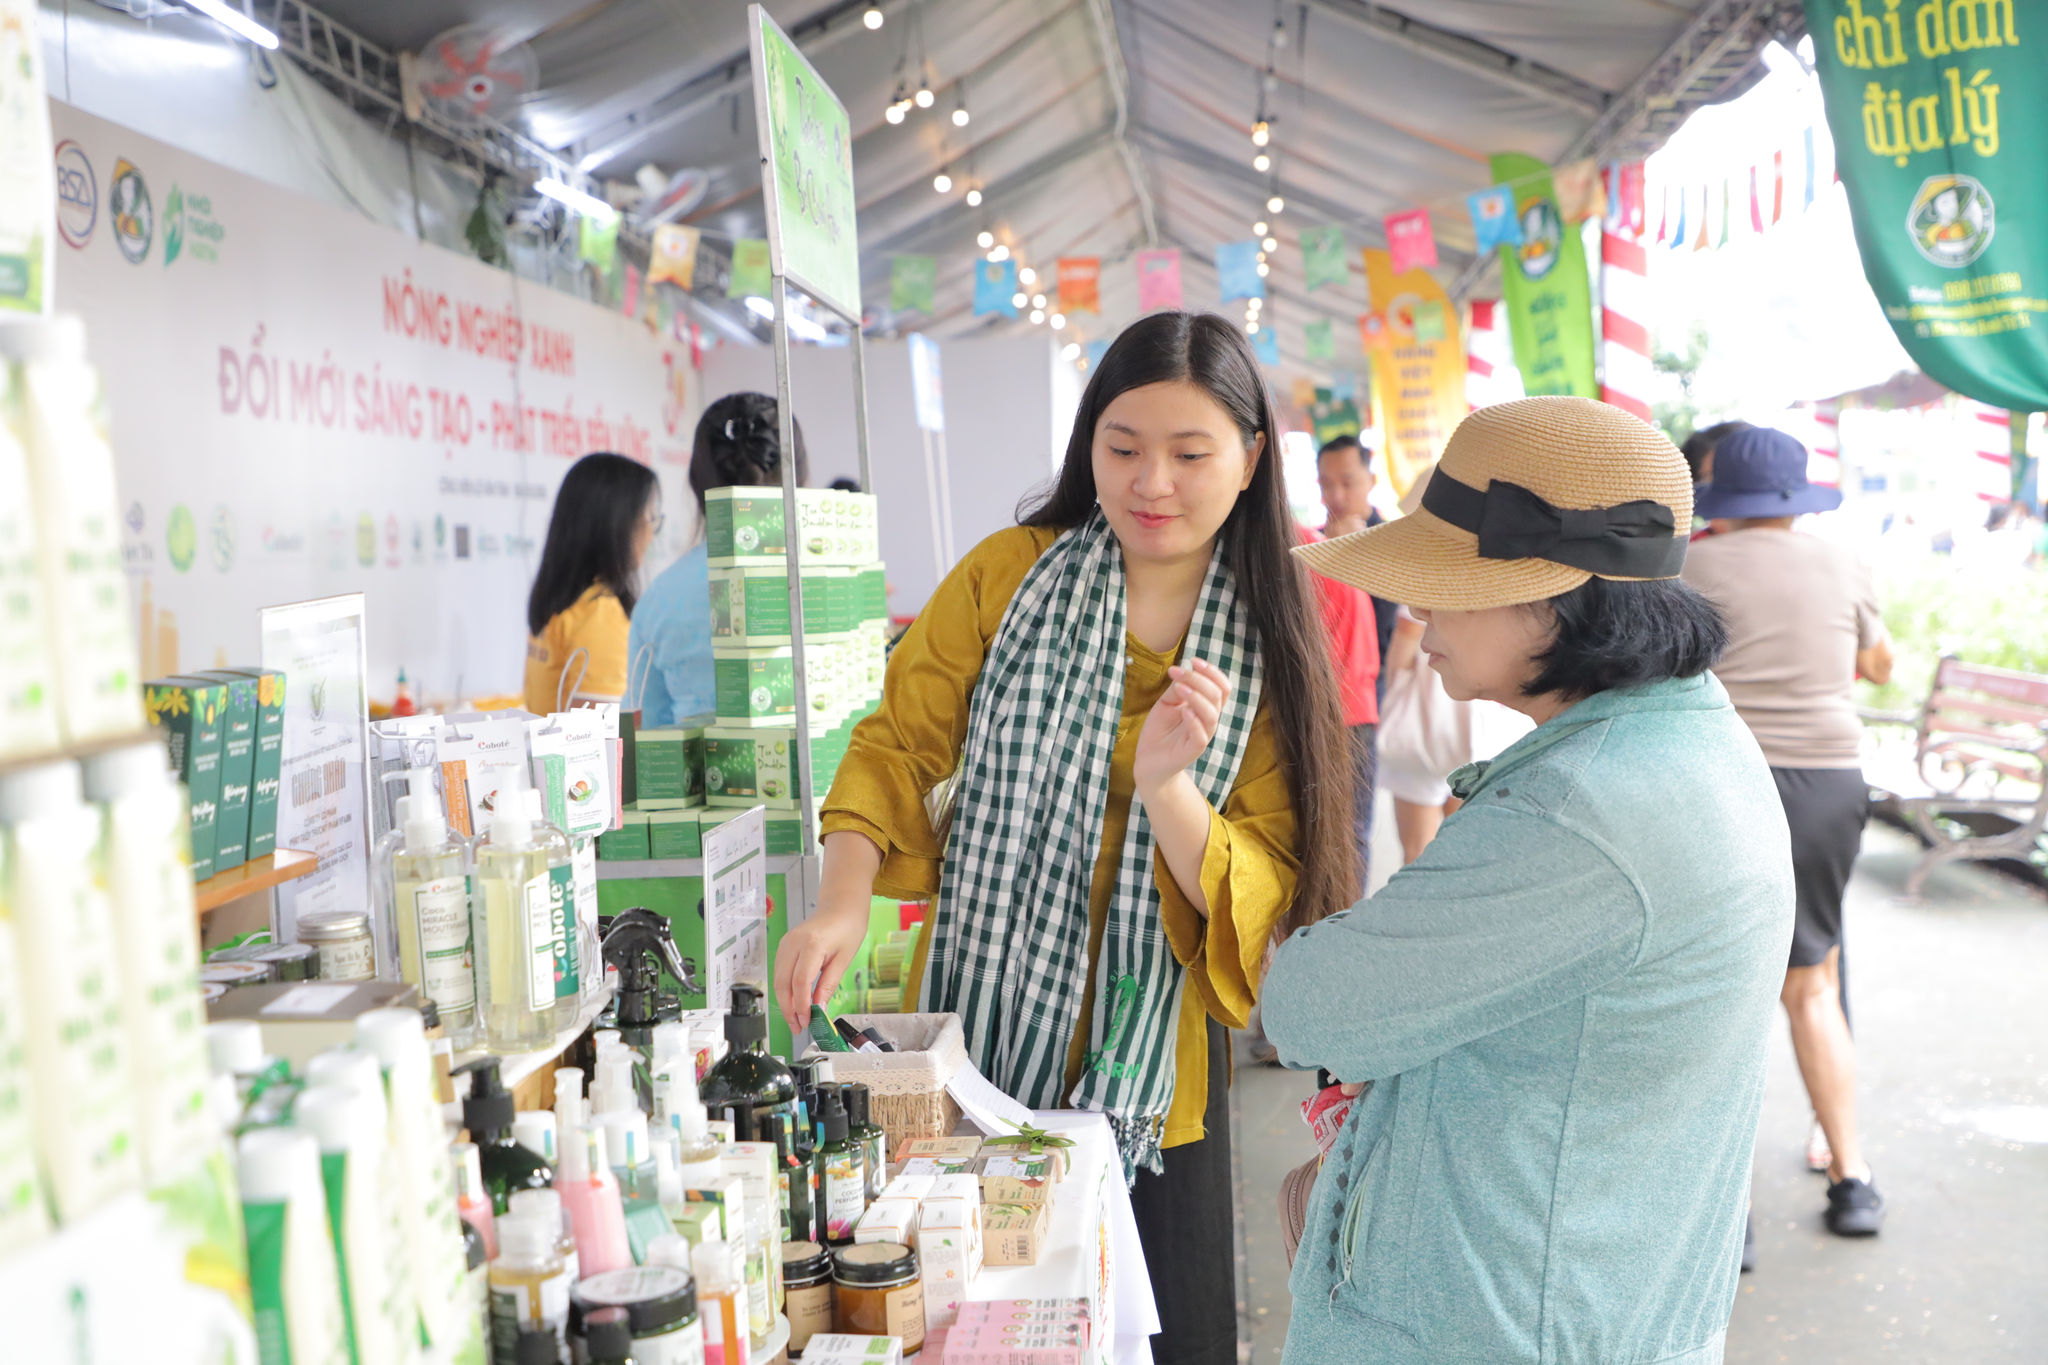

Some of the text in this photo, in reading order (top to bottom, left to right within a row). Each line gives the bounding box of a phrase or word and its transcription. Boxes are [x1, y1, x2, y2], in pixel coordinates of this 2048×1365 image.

[1863, 67, 2000, 168] địa lý
[381, 266, 452, 348] NÔNG
[457, 300, 524, 379] NGHIỆP
[218, 320, 280, 422] ĐỔI
[289, 346, 347, 430] MỚI
[353, 359, 423, 440] SÁNG
[427, 387, 473, 461] TẠO
